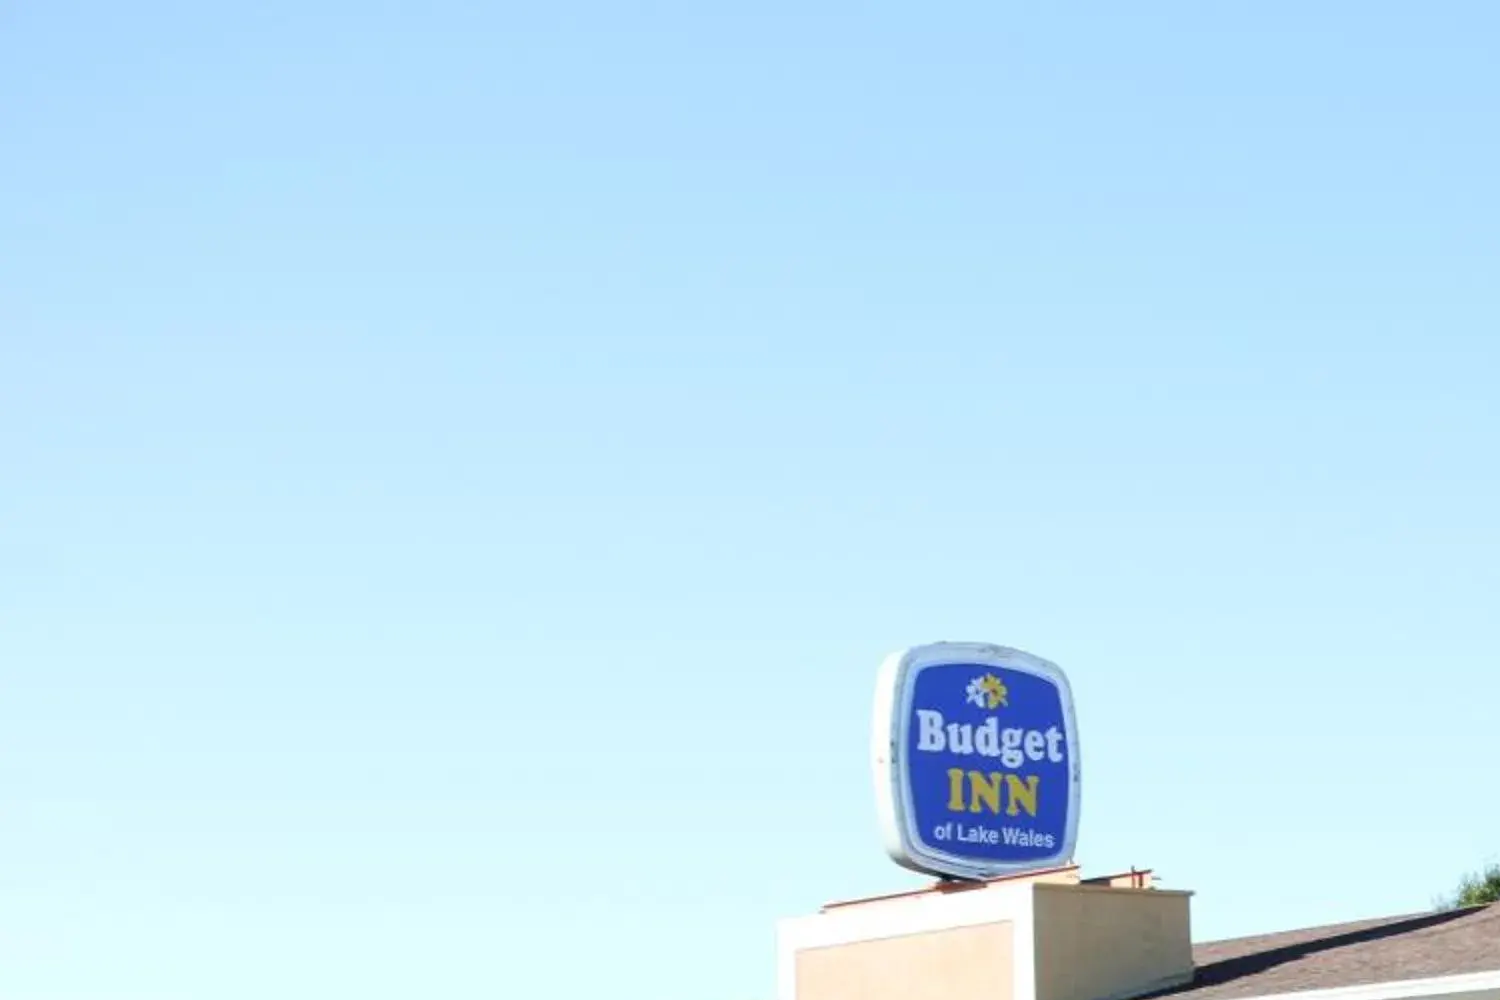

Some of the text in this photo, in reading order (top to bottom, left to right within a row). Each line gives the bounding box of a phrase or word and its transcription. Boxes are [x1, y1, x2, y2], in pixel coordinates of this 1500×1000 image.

[916, 709, 1064, 768] Budget
[947, 768, 1040, 817] INN
[934, 822, 1056, 849] of Lake Wales
